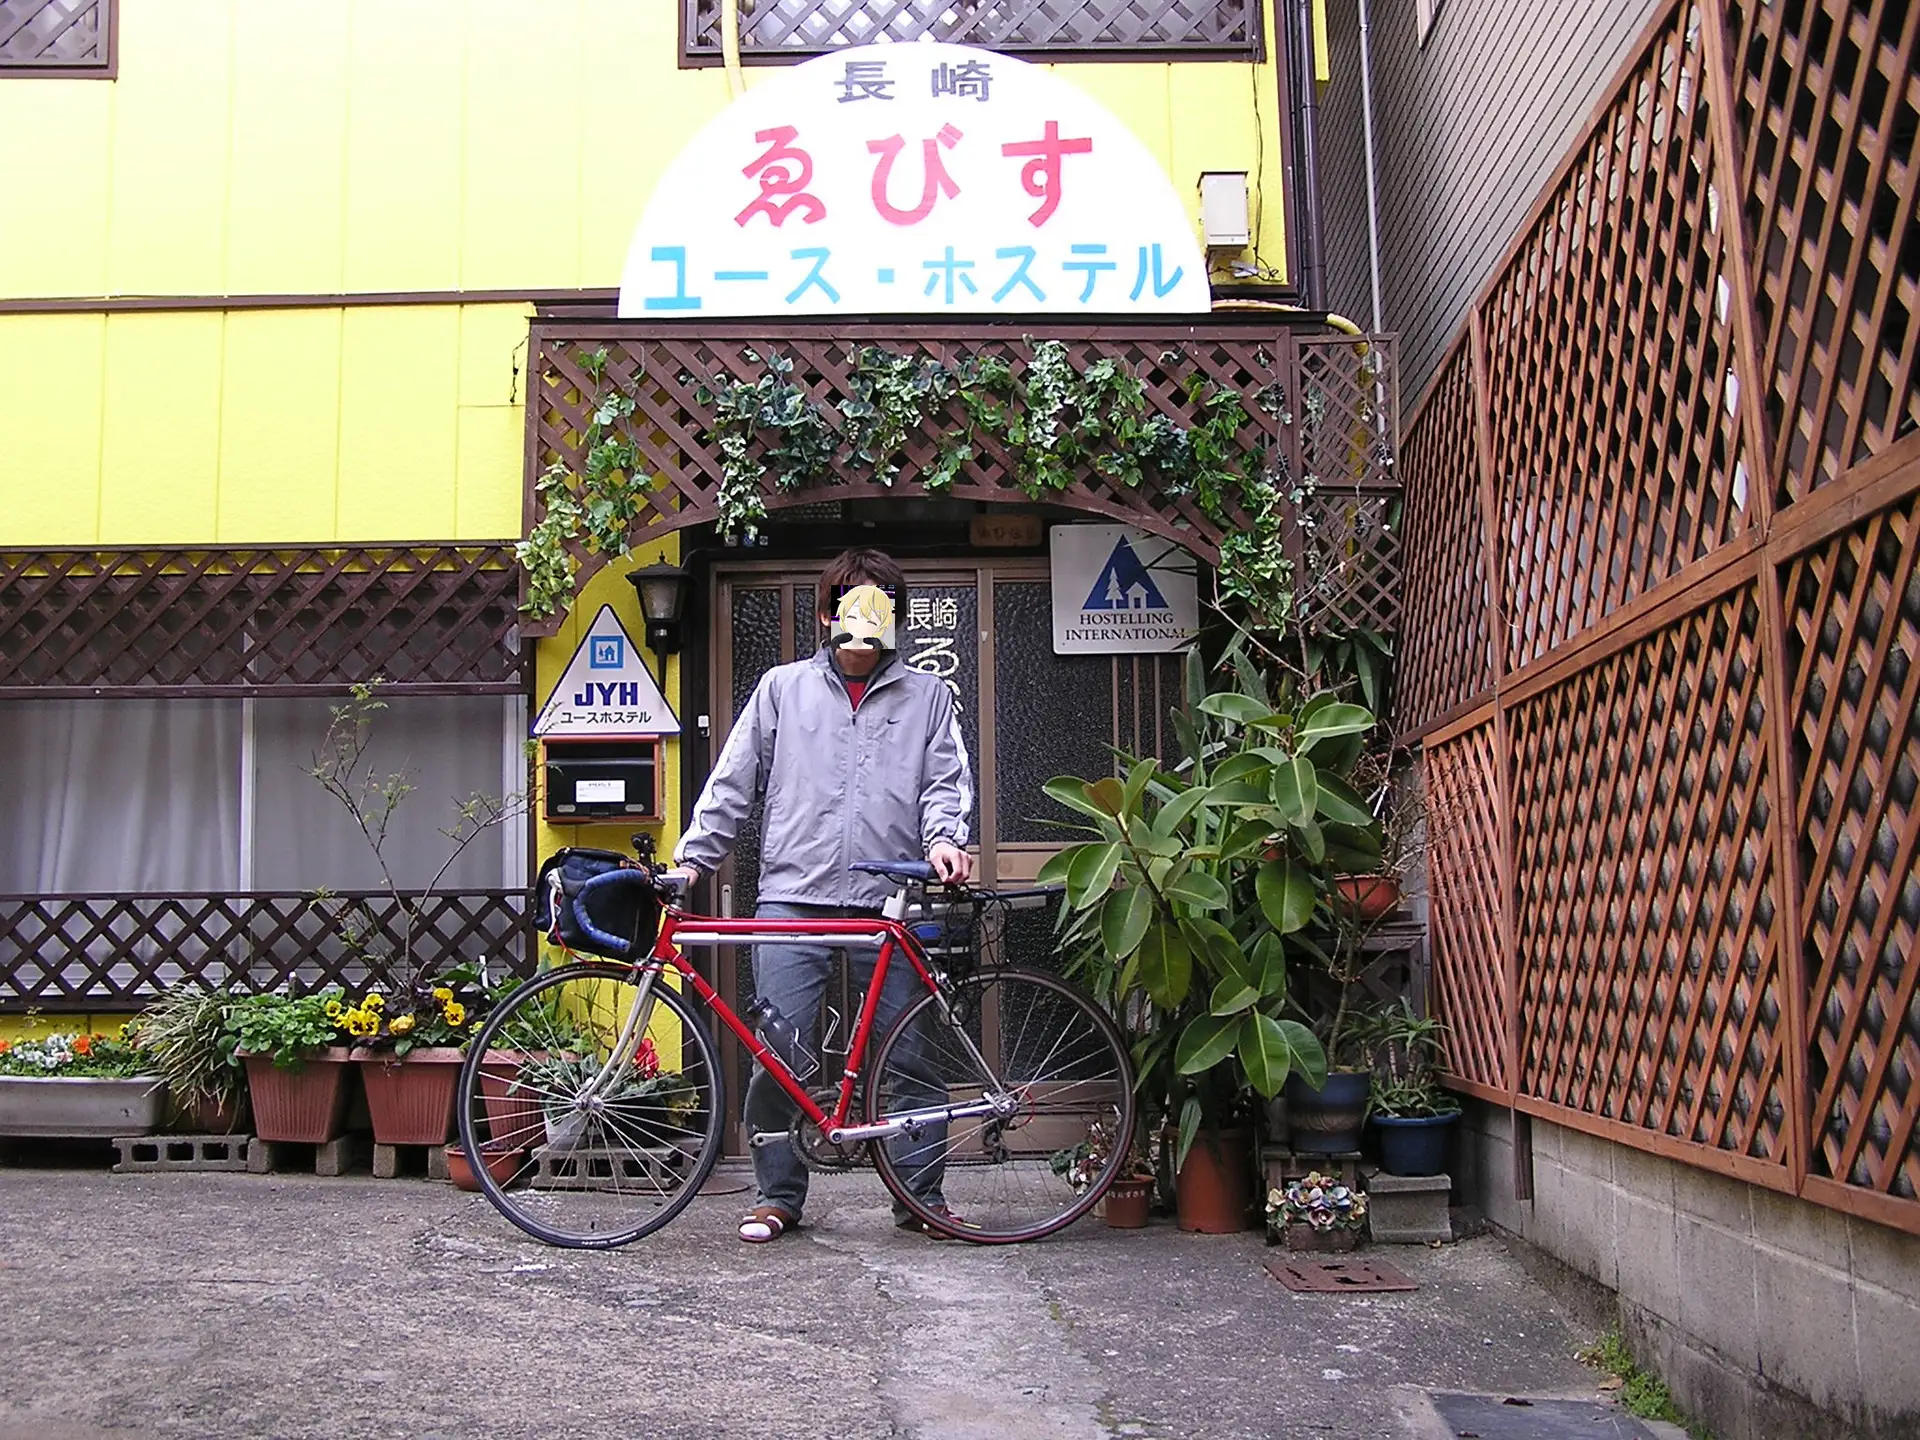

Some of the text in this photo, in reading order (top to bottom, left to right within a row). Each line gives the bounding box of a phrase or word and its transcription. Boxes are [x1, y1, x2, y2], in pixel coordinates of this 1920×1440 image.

[834, 59, 994, 104] 長崎
[734, 120, 1093, 228] ゑびす
[643, 243, 1184, 311] ユース・ホステル
[906, 597, 959, 632] 長崎
[1080, 613, 1175, 625] HOSTELLING
[1066, 627, 1189, 641] INTERNATIONAL
[574, 682, 638, 707] JYH
[560, 711, 652, 724] ユースホステル
